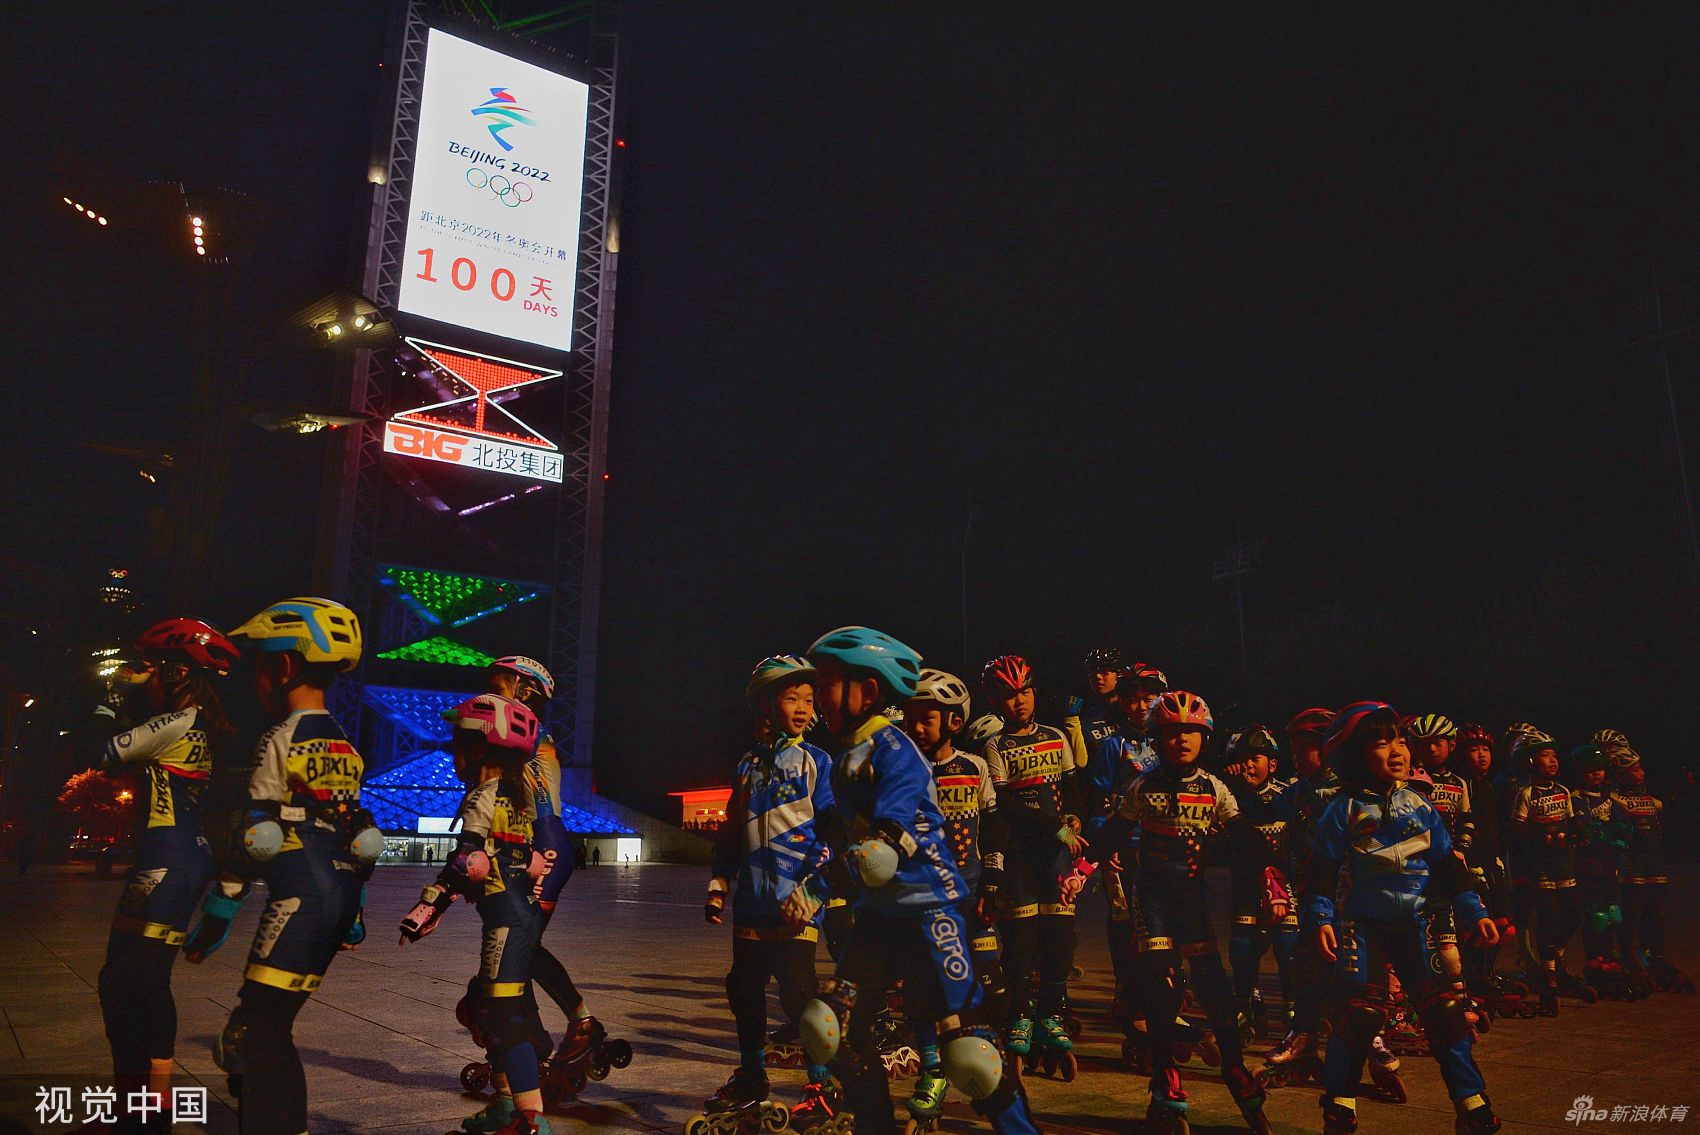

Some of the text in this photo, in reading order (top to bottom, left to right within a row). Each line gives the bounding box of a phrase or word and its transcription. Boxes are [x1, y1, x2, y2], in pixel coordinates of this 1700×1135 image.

[449, 141, 552, 183] BEIJING 2022
[416, 248, 516, 301] 100
[529, 276, 552, 301] 天
[523, 299, 559, 317] DAYS
[388, 424, 470, 462] BIG
[472, 444, 562, 479] 北投集团
